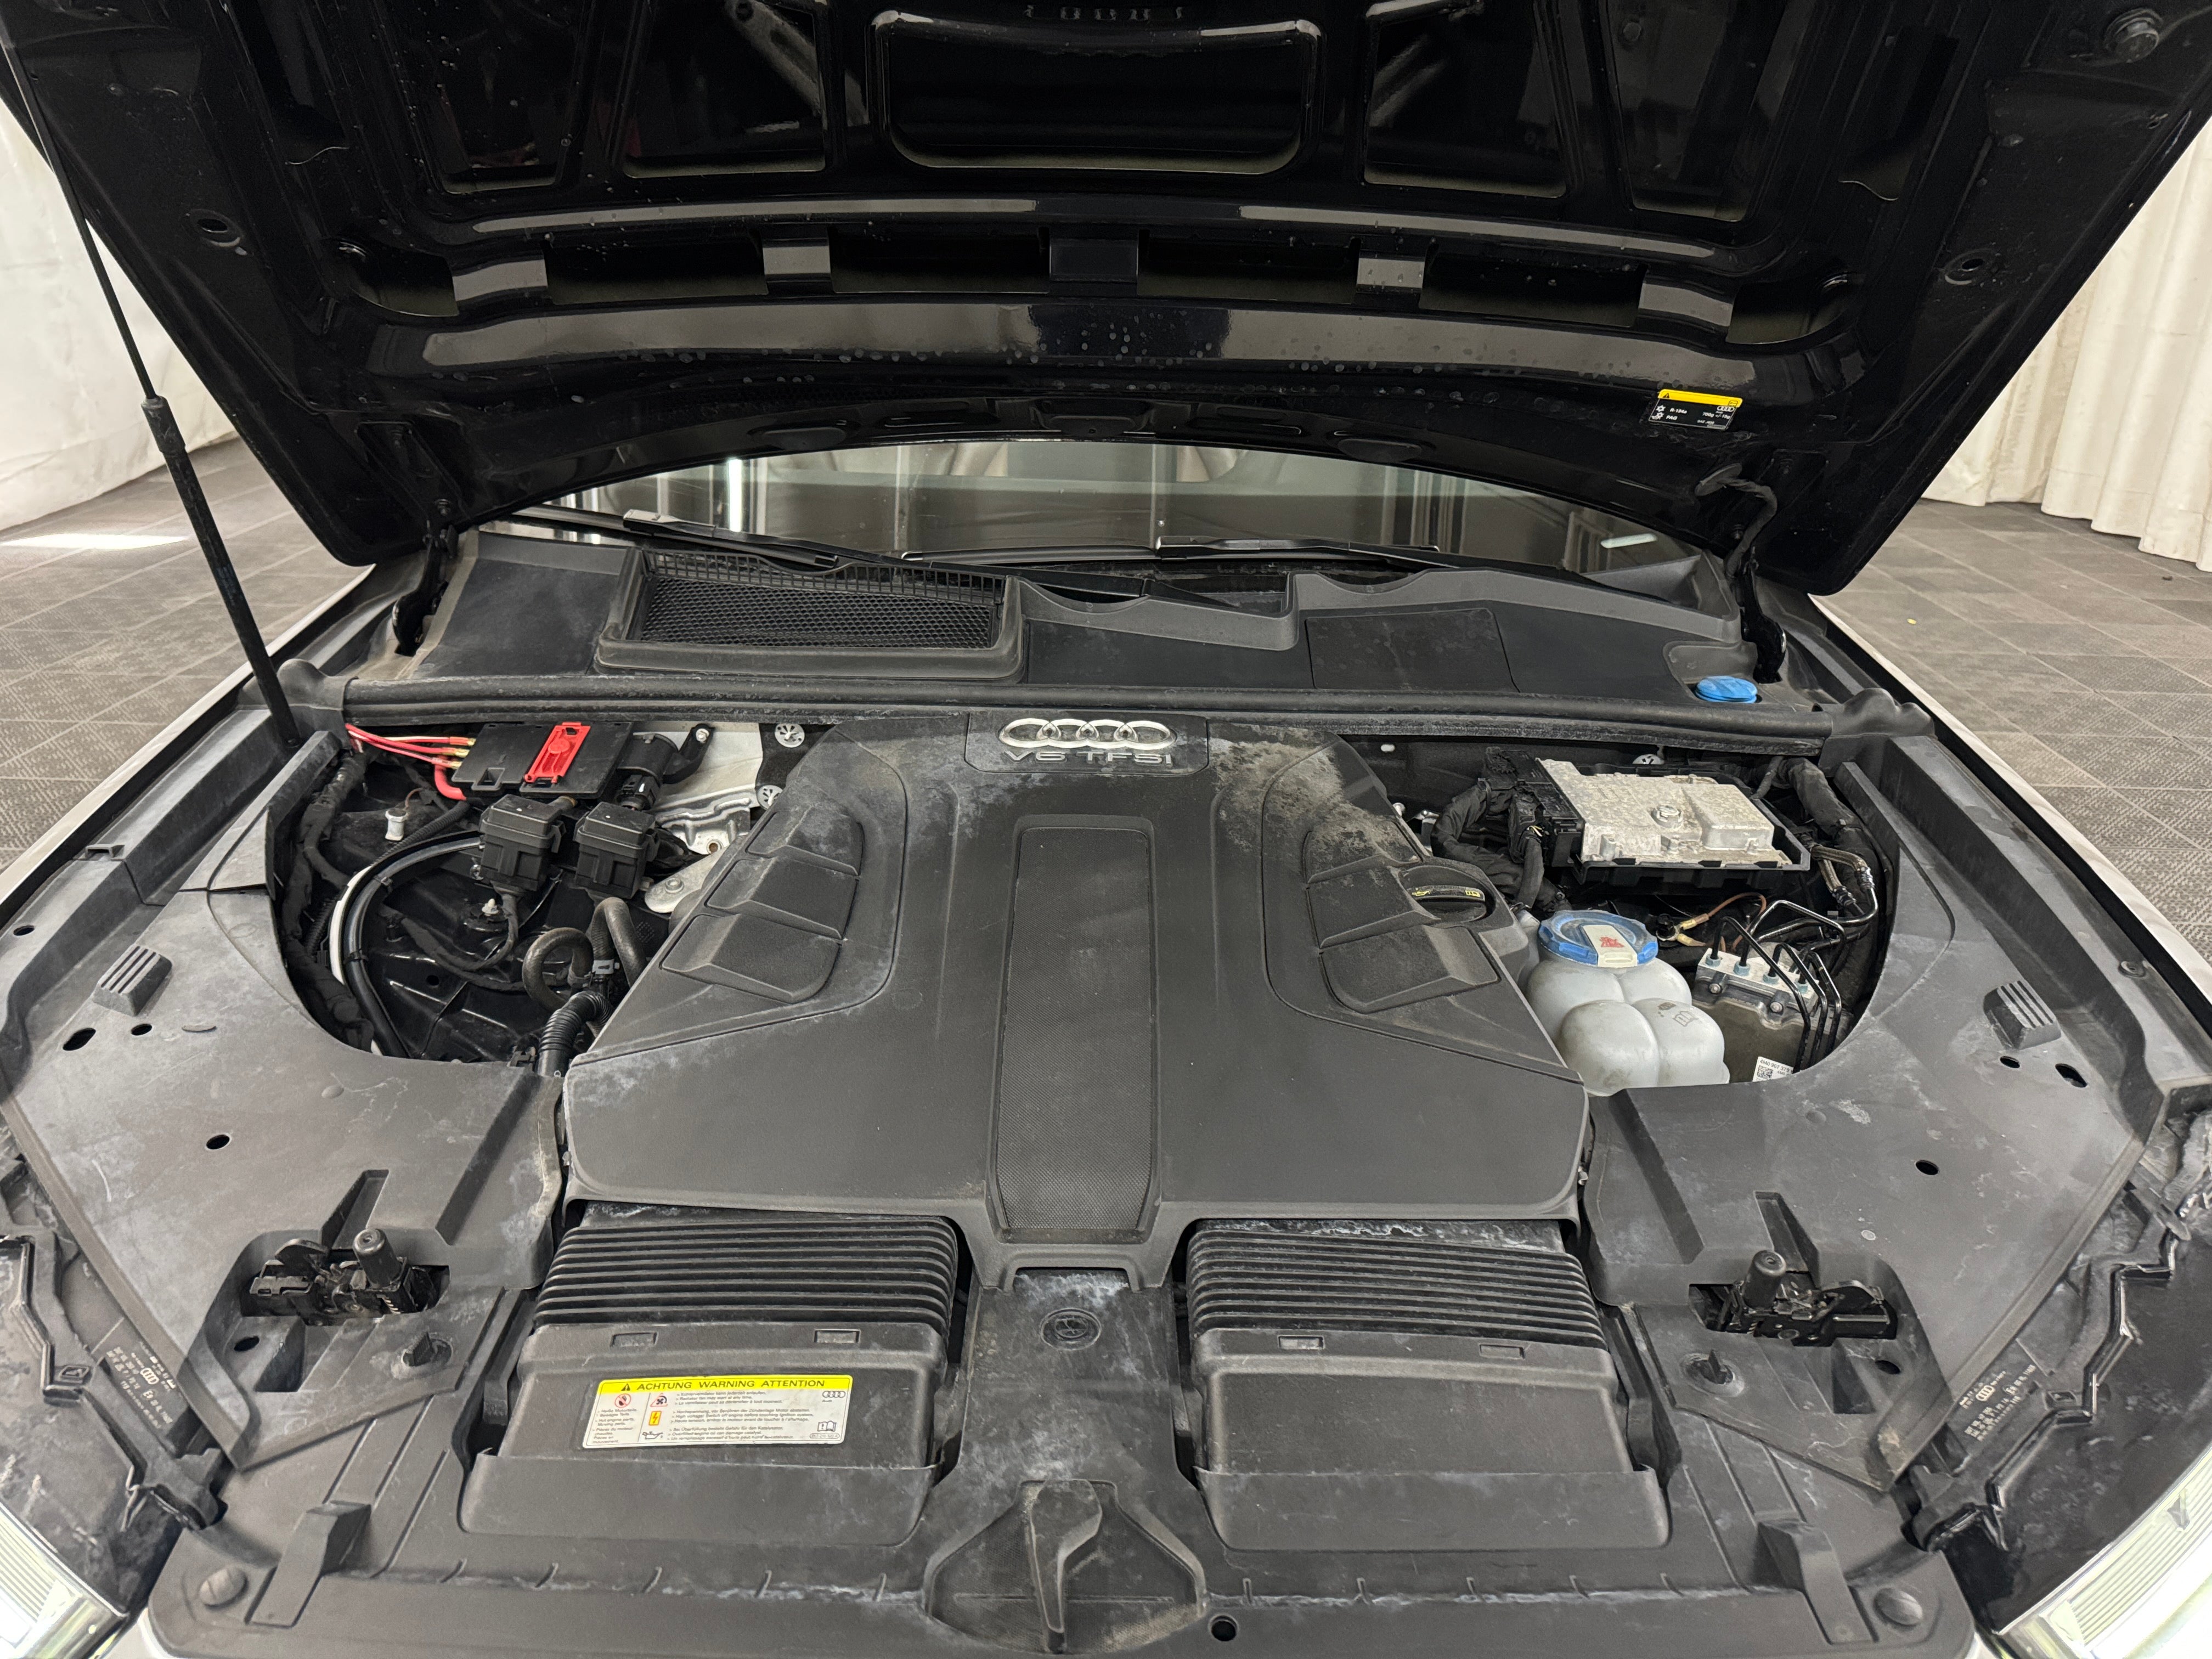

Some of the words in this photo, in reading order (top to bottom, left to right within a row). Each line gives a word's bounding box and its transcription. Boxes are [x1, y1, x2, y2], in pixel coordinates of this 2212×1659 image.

[1004, 750, 1067, 764] V6
[1076, 751, 1172, 766] TFSI
[636, 1381, 692, 1391] ACHTUNG
[698, 1380, 755, 1389] WARNING
